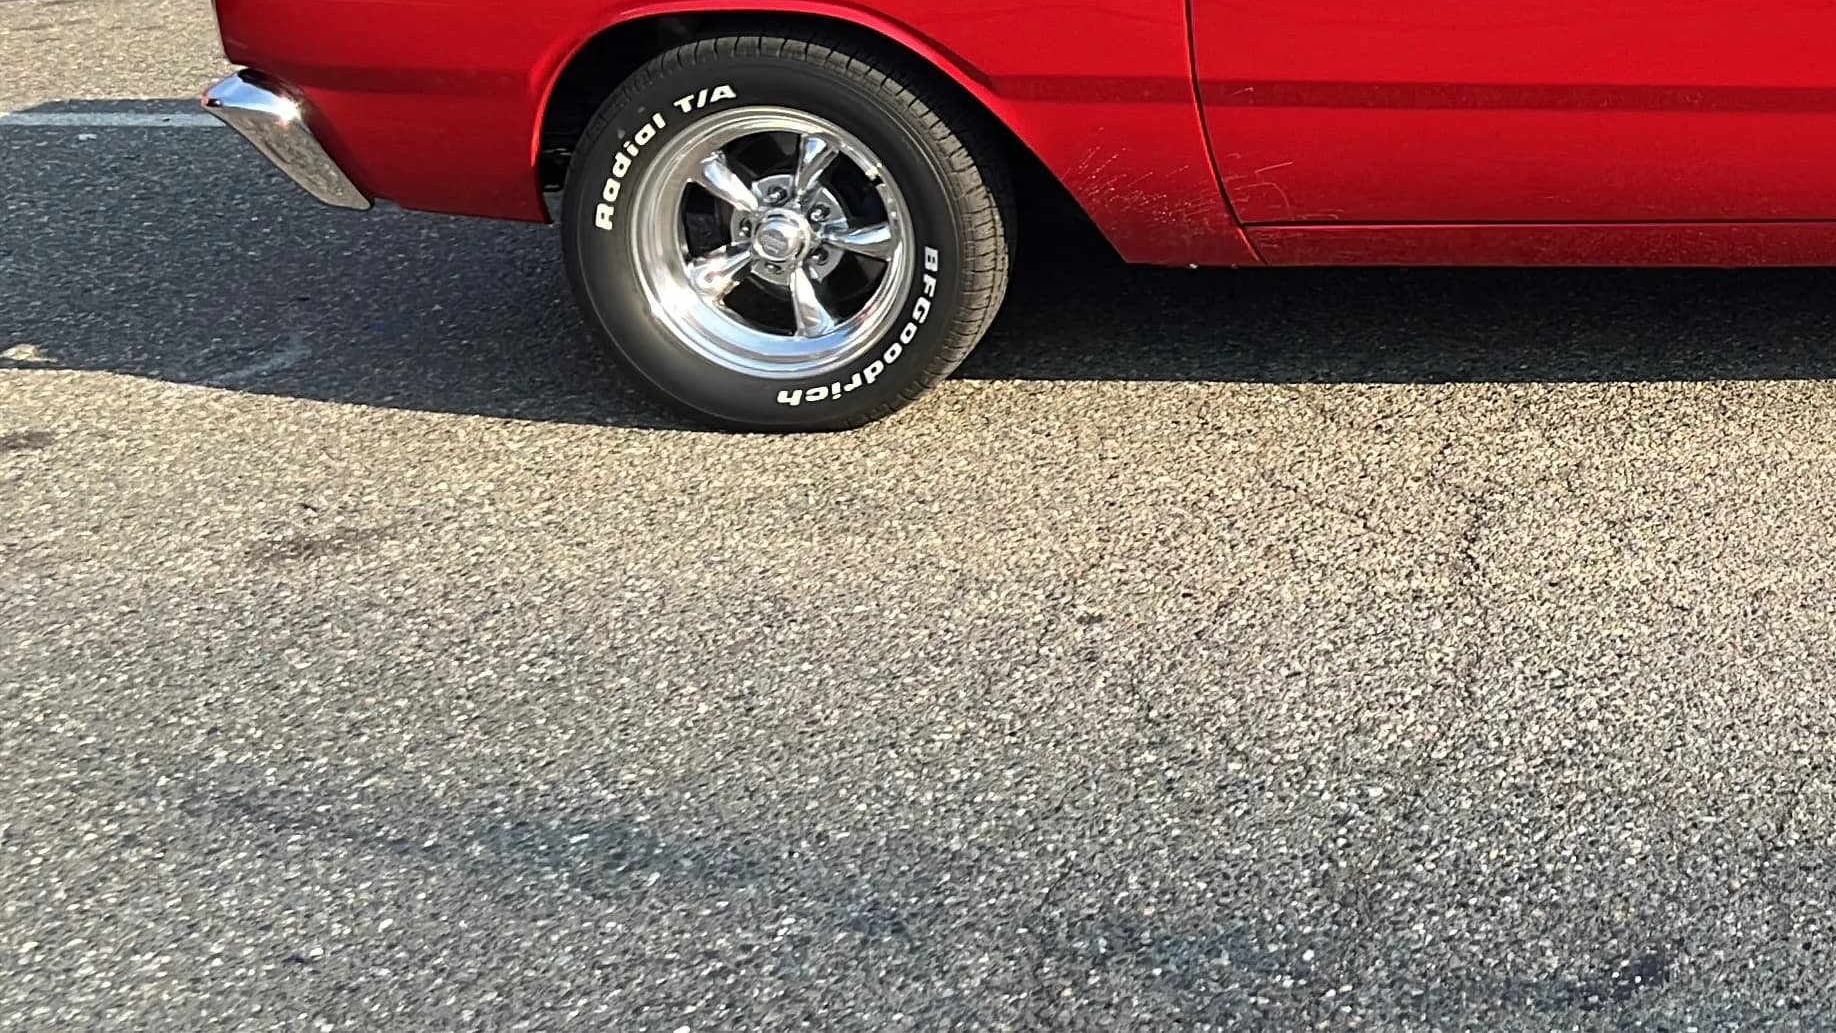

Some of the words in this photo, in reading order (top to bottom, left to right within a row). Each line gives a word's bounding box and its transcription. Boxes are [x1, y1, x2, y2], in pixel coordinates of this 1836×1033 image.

[595, 112, 666, 231] Radial
[674, 83, 737, 114] T/A
[777, 246, 939, 406] BFGoodrich
